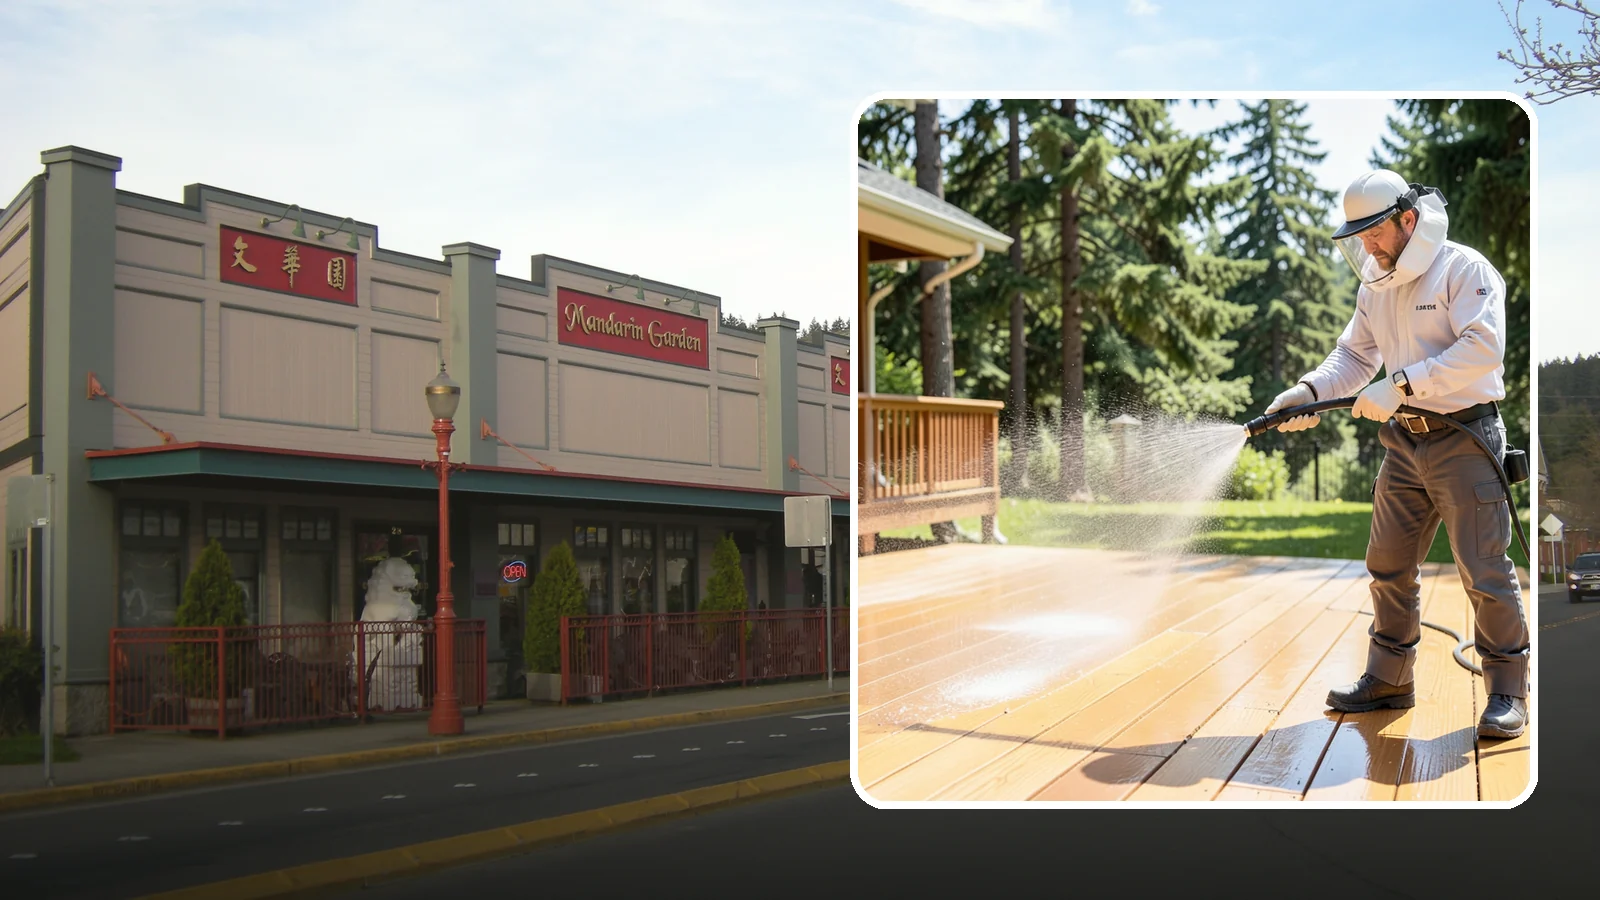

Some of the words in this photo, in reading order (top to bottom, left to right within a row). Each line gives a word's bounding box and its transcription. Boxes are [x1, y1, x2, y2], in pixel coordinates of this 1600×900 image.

[231, 236, 346, 291] 文華園
[565, 302, 643, 340] Mandarin
[648, 320, 701, 352] Garden
[503, 565, 527, 578] OPEN
